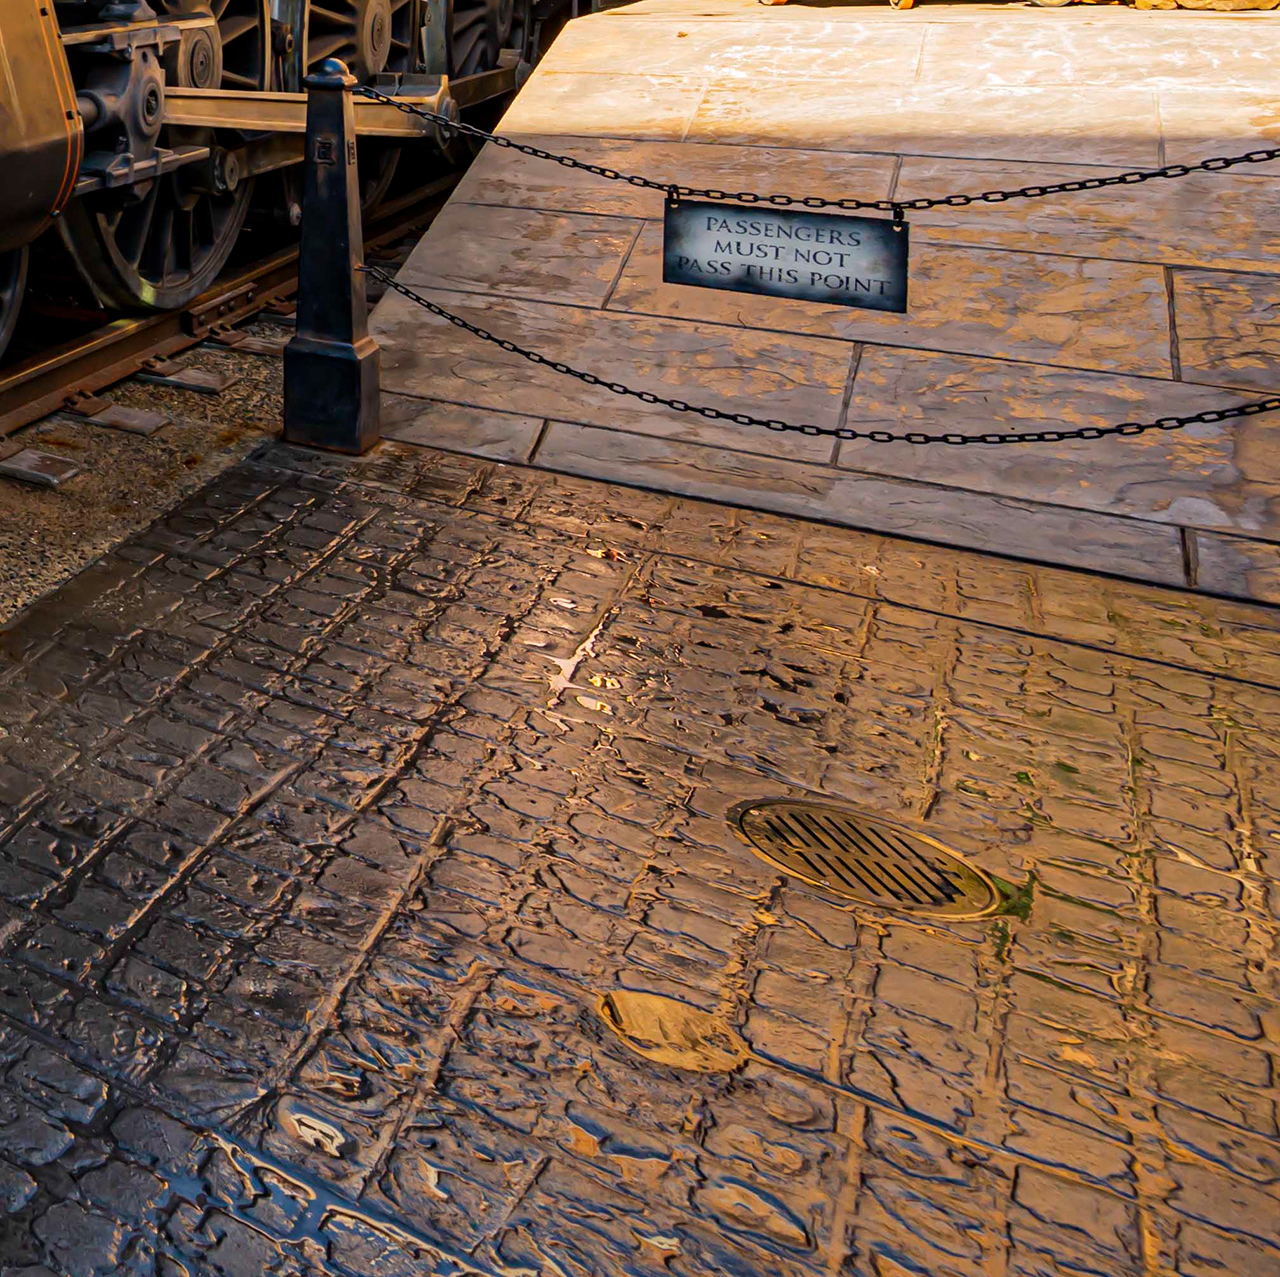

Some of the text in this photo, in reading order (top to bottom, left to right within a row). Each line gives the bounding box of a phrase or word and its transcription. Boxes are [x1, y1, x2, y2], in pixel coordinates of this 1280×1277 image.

[706, 216, 861, 247] PASSENGERS
[714, 239, 851, 268] MUST NOT
[677, 255, 892, 295] PASS THIS POINT
